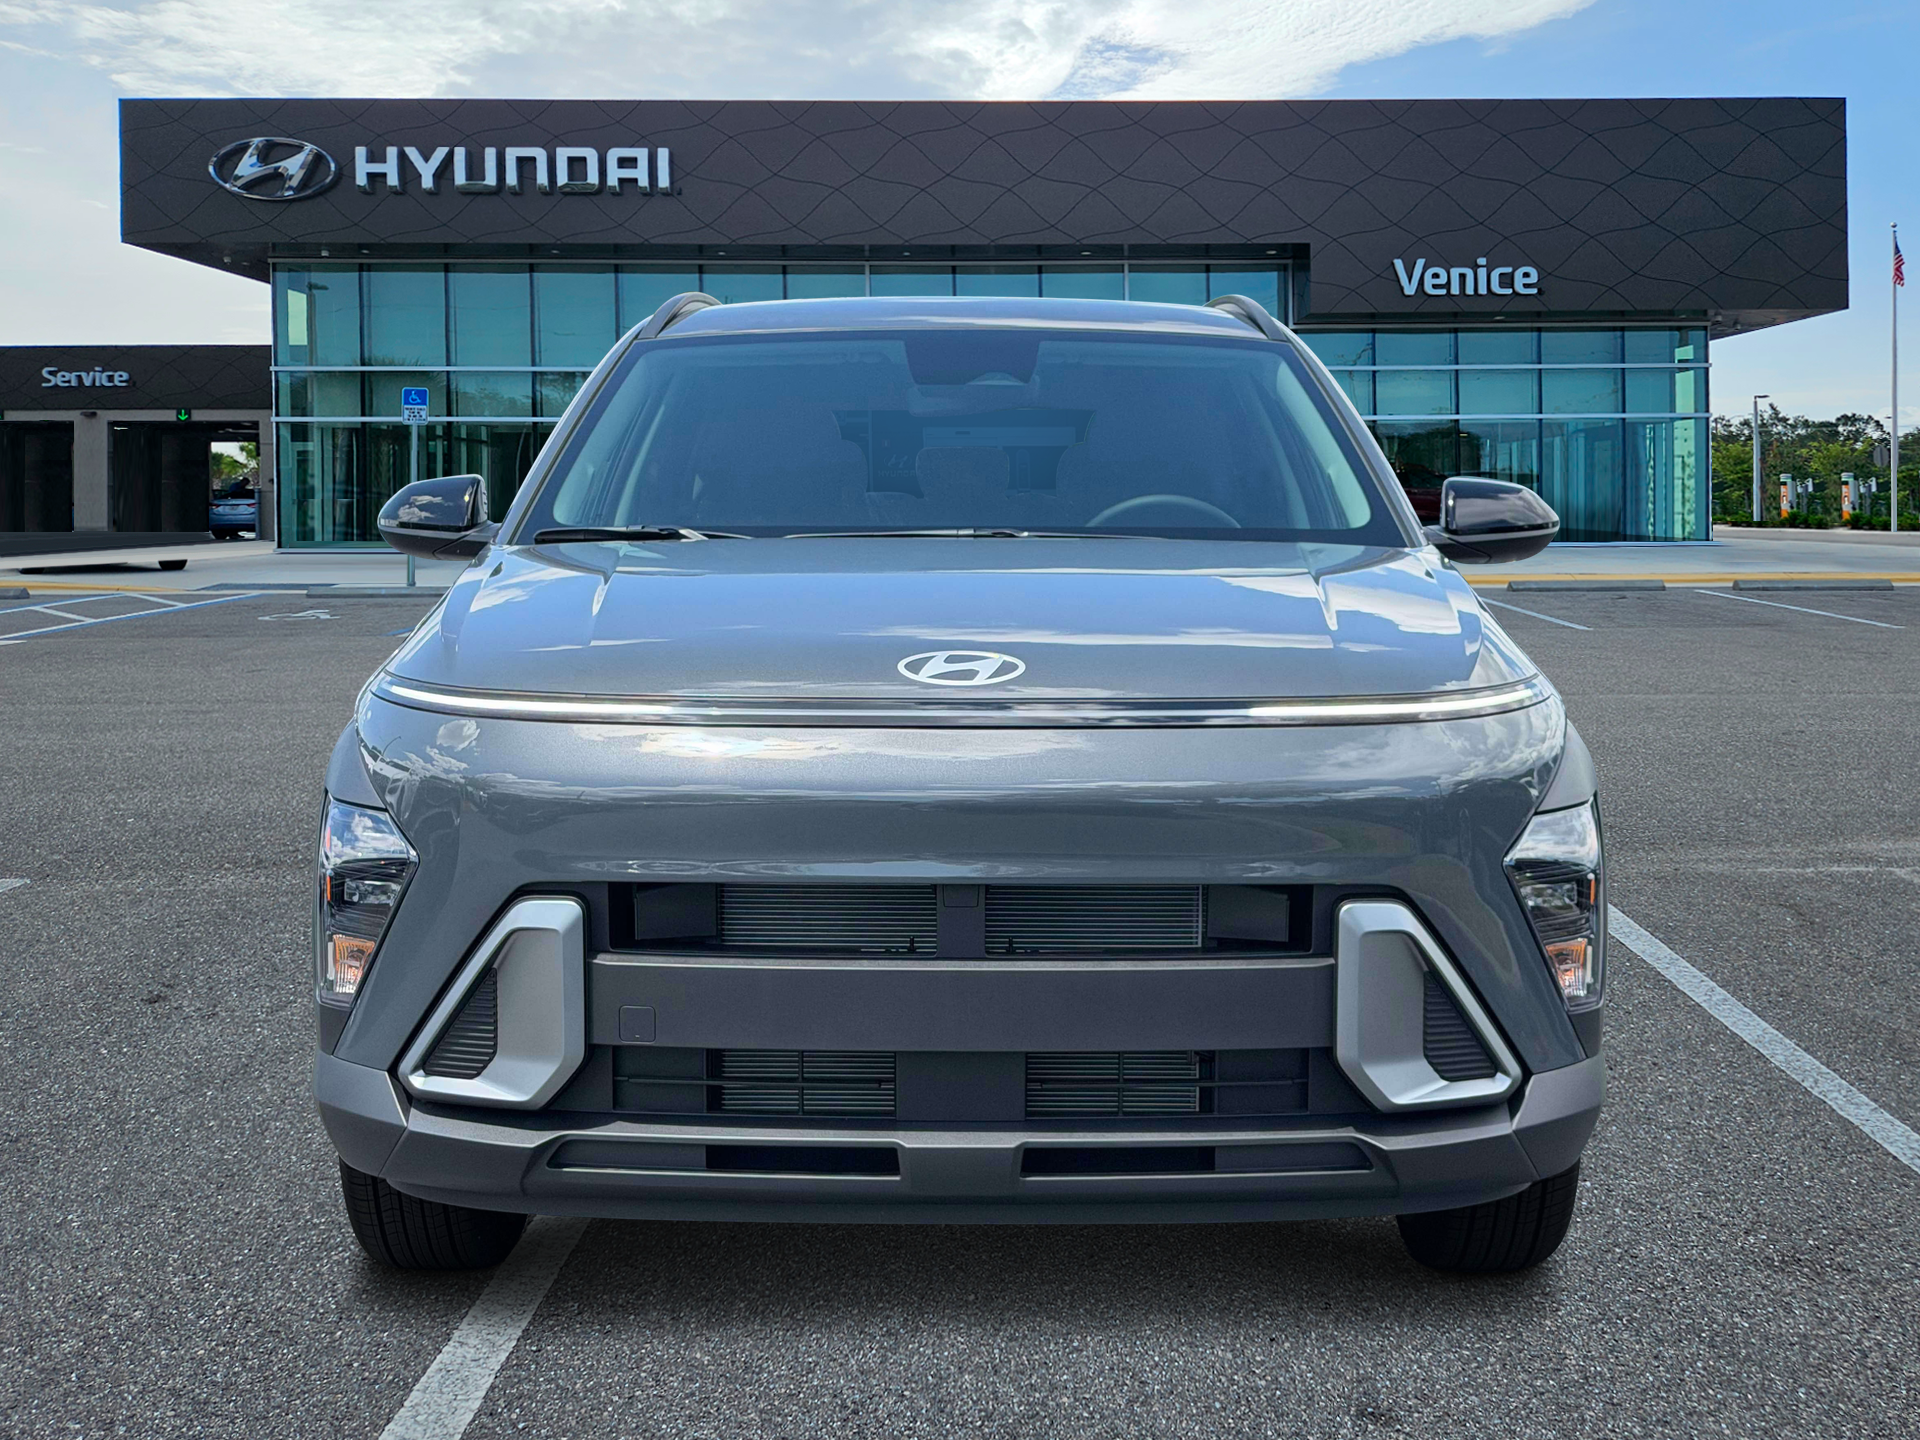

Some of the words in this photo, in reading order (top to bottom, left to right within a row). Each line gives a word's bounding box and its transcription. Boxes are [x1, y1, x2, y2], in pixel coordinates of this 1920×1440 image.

[354, 146, 673, 193] HYUNDAI
[1393, 257, 1538, 295] Venice
[41, 366, 130, 387] Service
